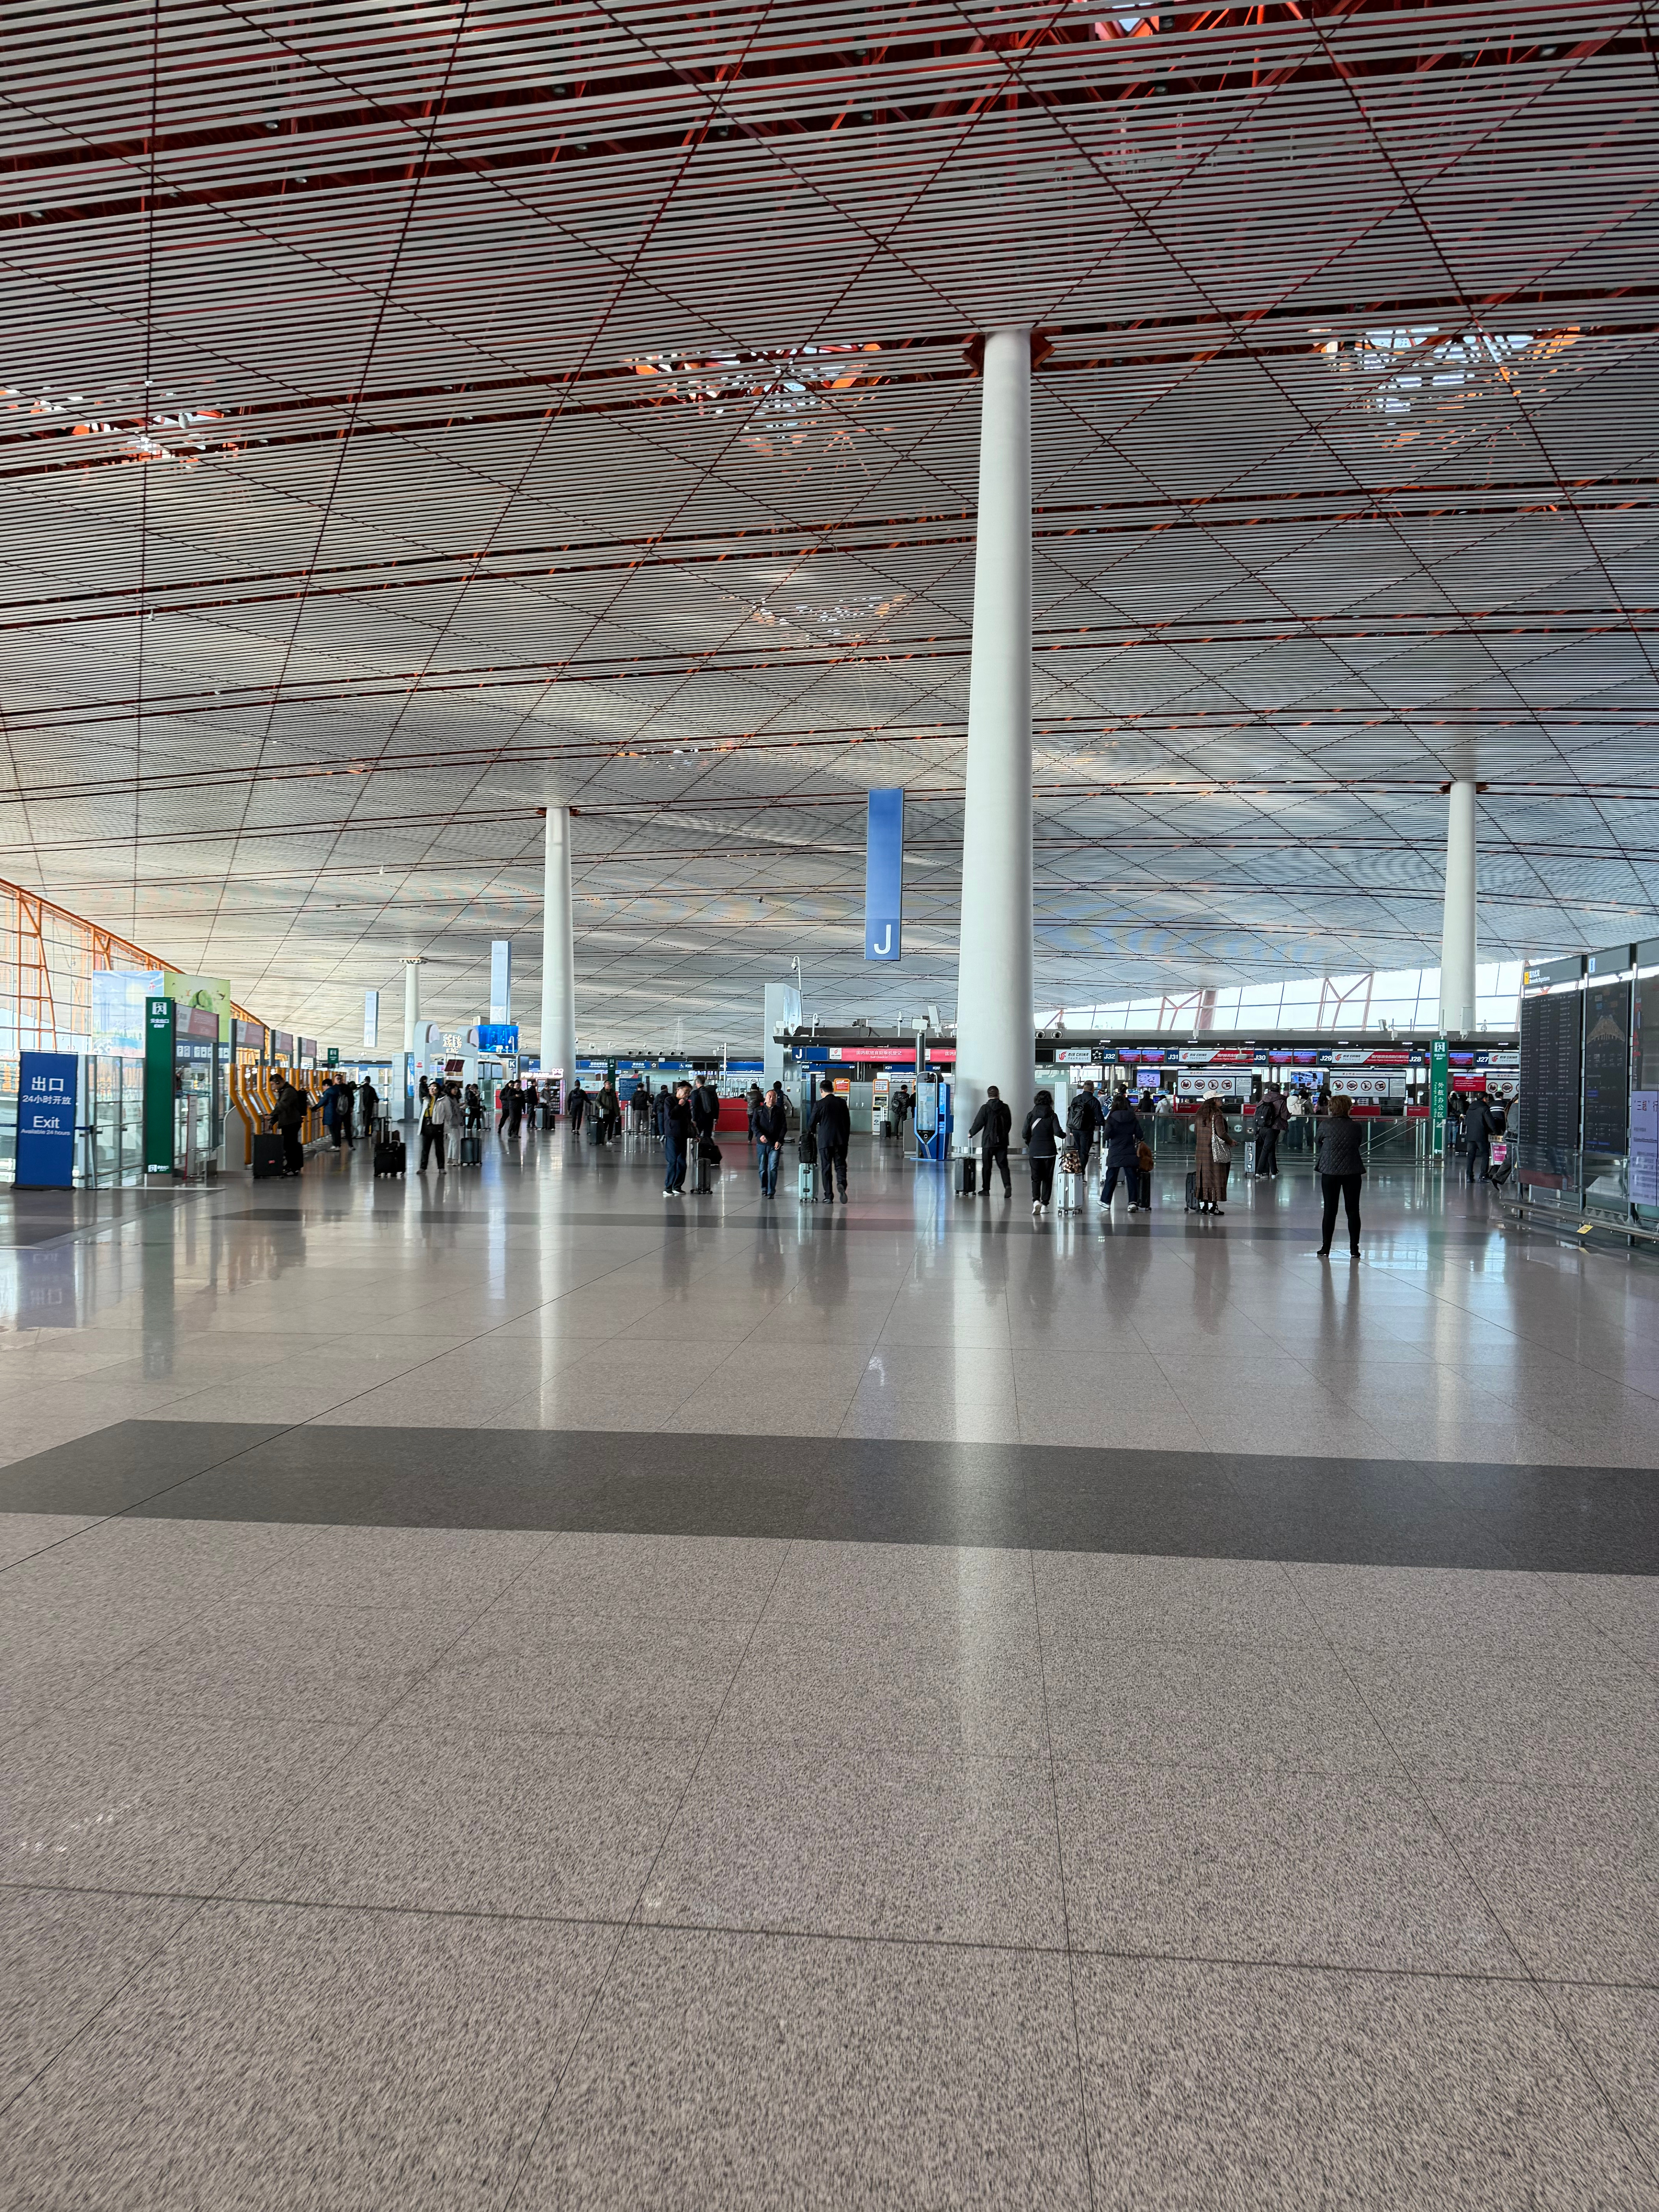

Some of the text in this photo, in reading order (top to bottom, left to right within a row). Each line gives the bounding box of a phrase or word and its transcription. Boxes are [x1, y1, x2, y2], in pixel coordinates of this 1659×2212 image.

[874, 924, 891, 955] J
[795, 1049, 802, 1059] J
[31, 1076, 64, 1091] 出口
[22, 1095, 72, 1105] 24小时开放
[33, 1116, 60, 1128] Exit
